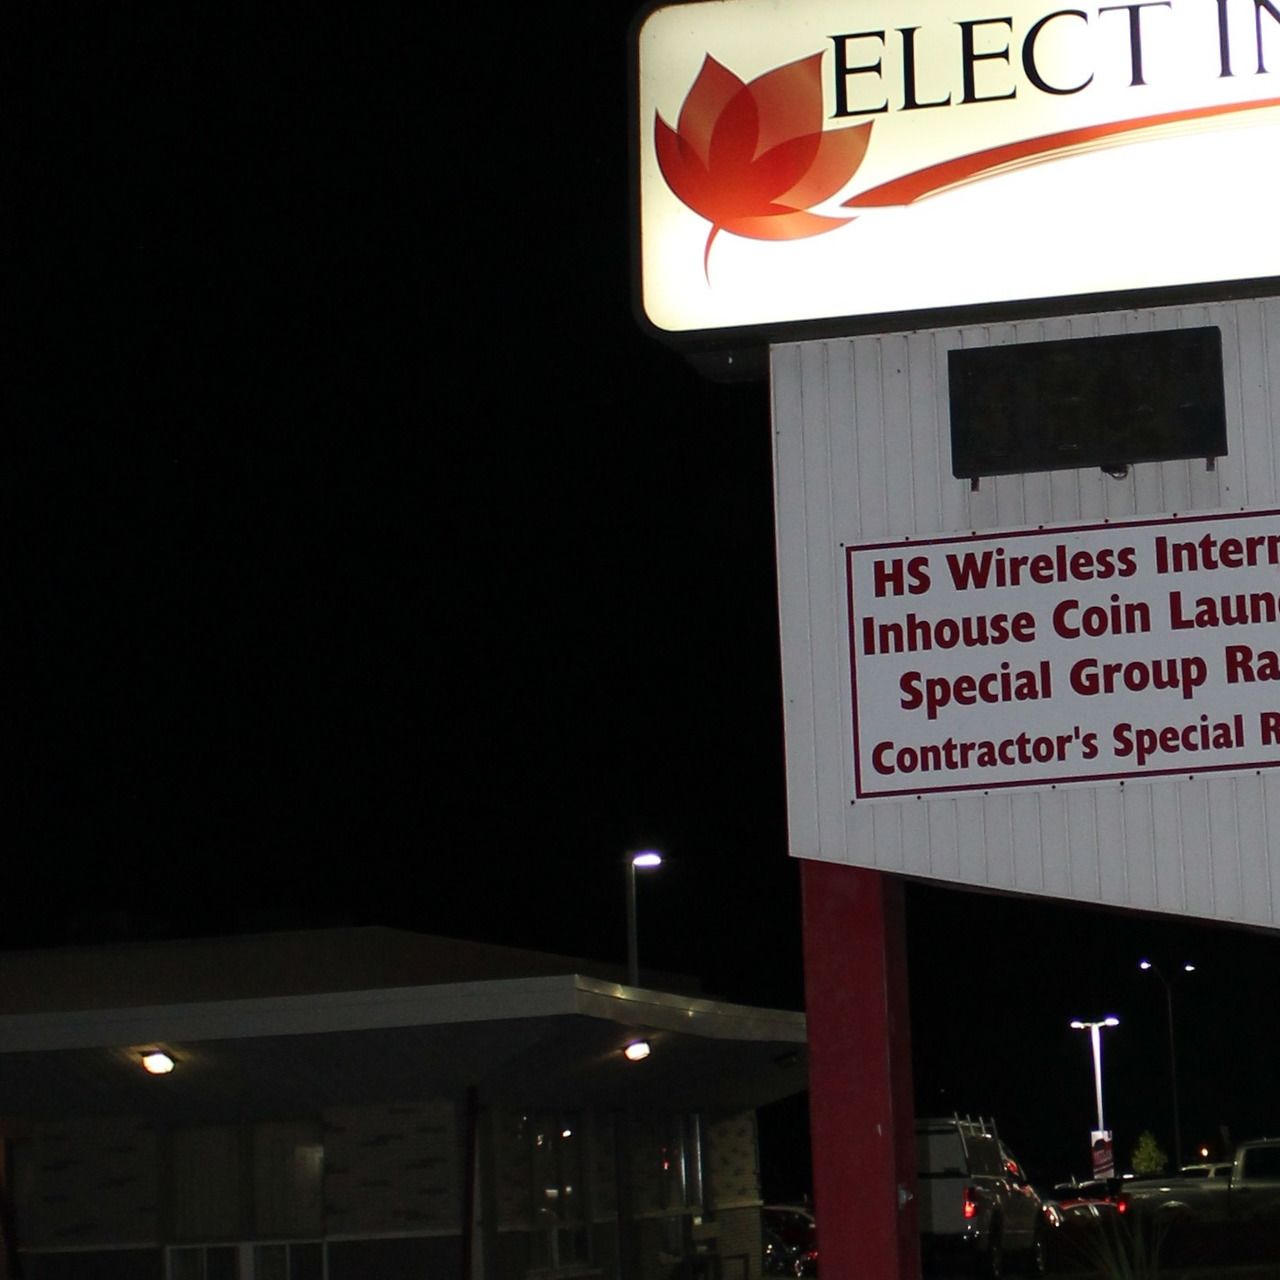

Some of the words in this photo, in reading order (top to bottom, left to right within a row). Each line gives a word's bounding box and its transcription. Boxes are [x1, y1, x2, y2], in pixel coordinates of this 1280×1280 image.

[828, 0, 1172, 120] ELECT
[873, 555, 932, 599] HS
[944, 544, 1138, 591] Wireless
[861, 610, 1037, 656] Inhouse
[1052, 592, 1151, 640] Coin
[898, 658, 1052, 721] Special
[1068, 656, 1209, 701] Group
[870, 725, 1100, 777] Contractor's
[1112, 712, 1246, 767] Special
